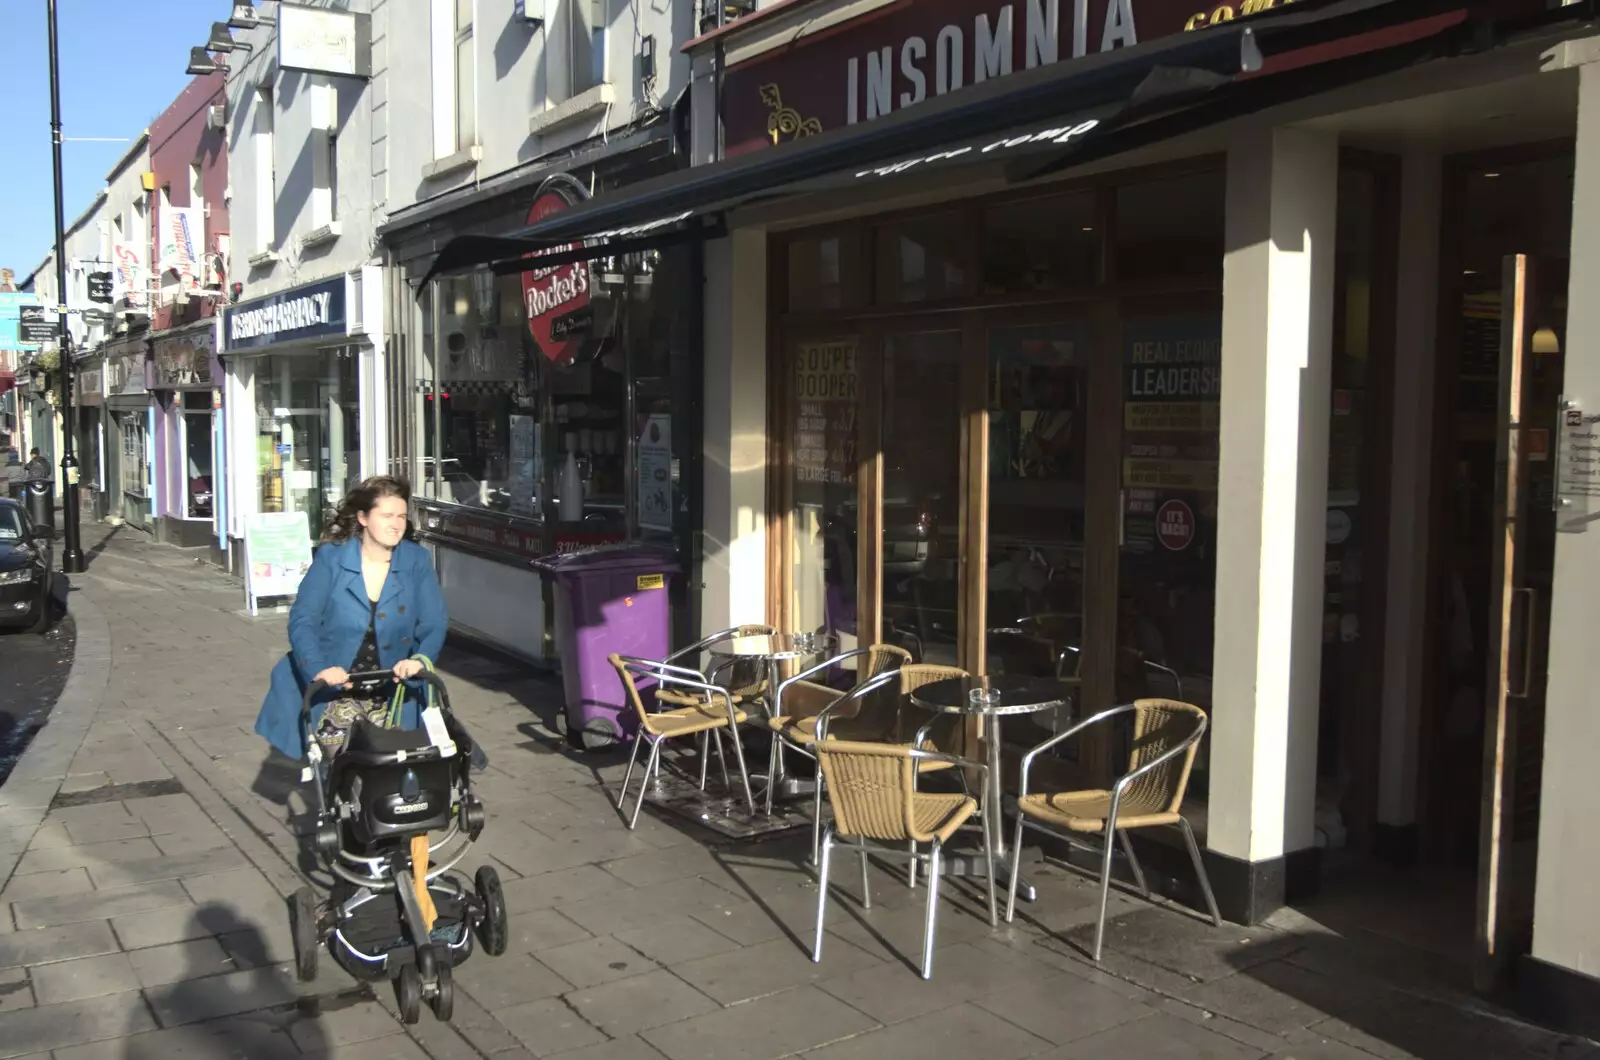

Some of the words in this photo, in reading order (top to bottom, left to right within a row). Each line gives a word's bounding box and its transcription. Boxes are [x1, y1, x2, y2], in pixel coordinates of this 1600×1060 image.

[1184, 0, 1294, 32] com
[847, 0, 1137, 126] INSOMNIA
[528, 261, 588, 318] Rocket's
[1132, 341, 1172, 364] REAL
[797, 373, 857, 398] DOOPER
[1132, 367, 1221, 395] LEADERSH
